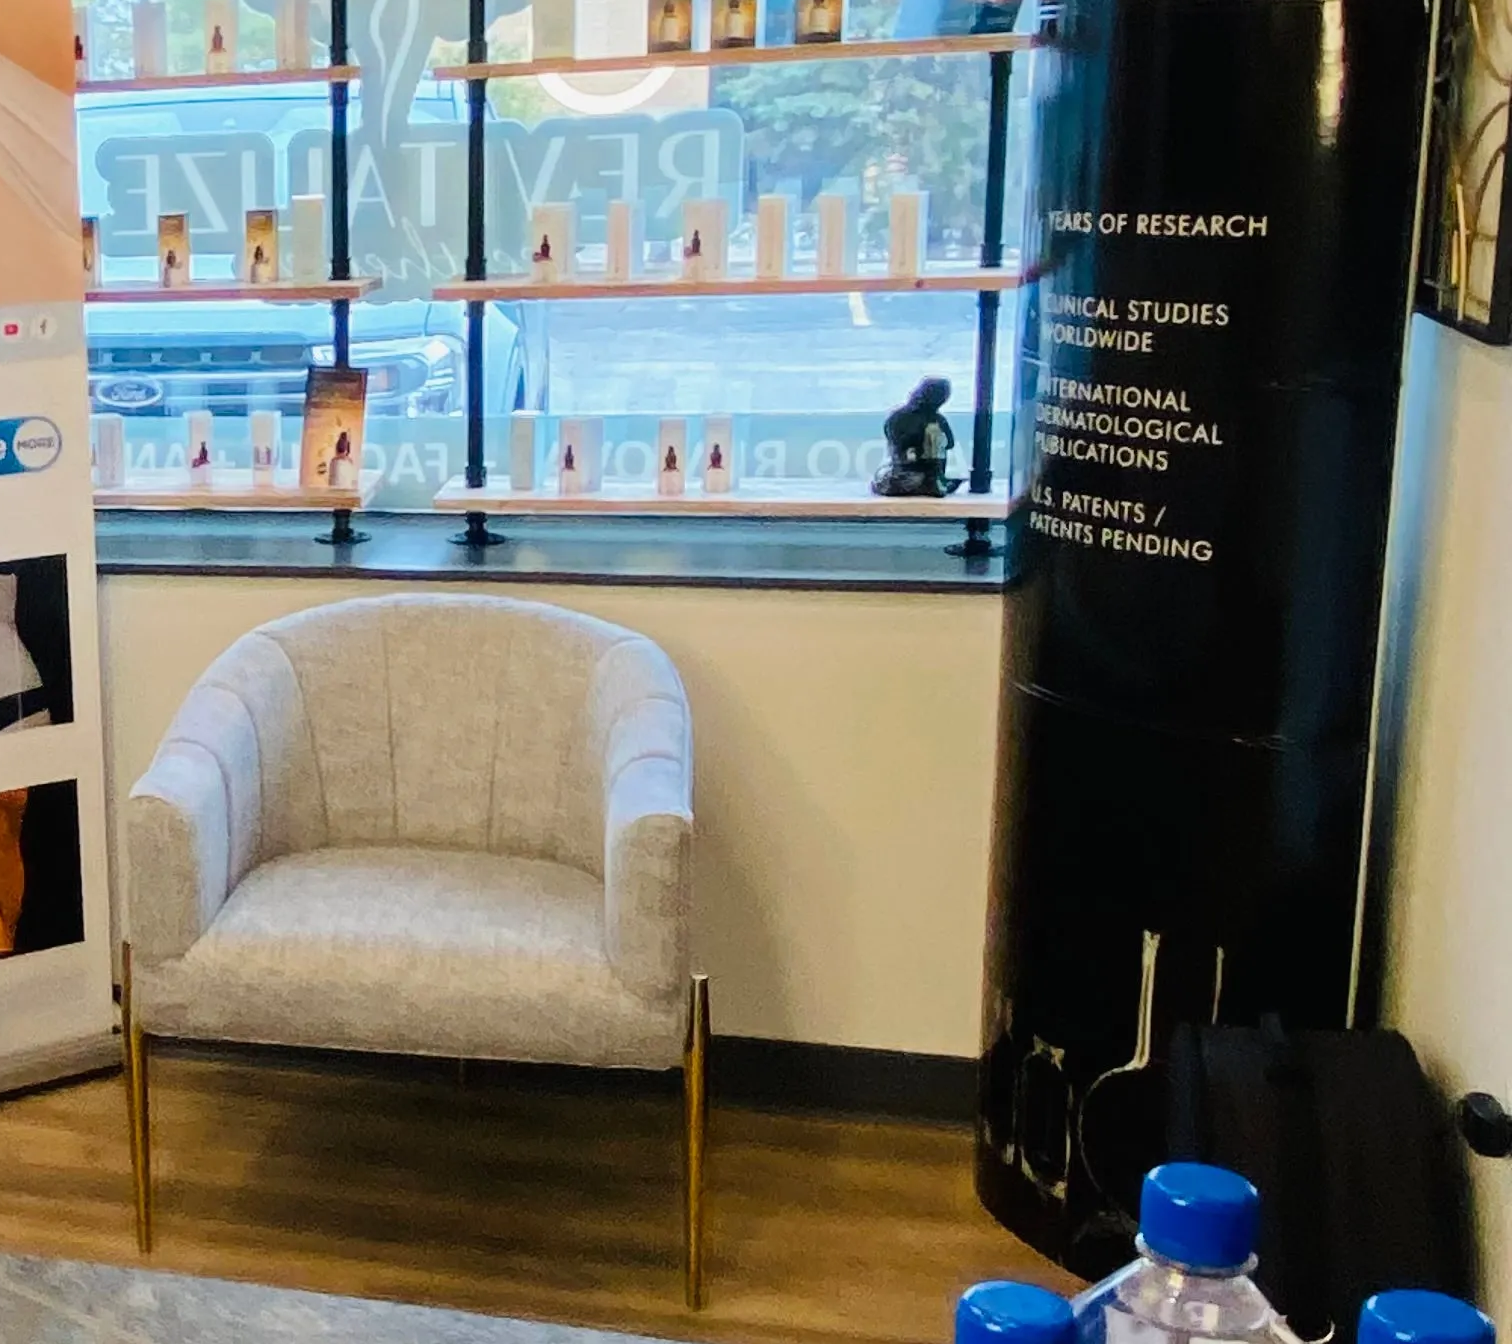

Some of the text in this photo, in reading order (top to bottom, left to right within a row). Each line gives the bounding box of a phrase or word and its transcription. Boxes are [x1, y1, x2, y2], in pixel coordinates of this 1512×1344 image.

[1099, 213, 1128, 235] OF
[1136, 214, 1269, 238] RESEARCH
[1128, 300, 1230, 327] STUDIES
[1034, 430, 1170, 472] PUBLICATIONS
[1031, 485, 1056, 508] U.S.
[1062, 491, 1145, 524] PATENTS
[1029, 511, 1214, 563] PATENTS PENDING
